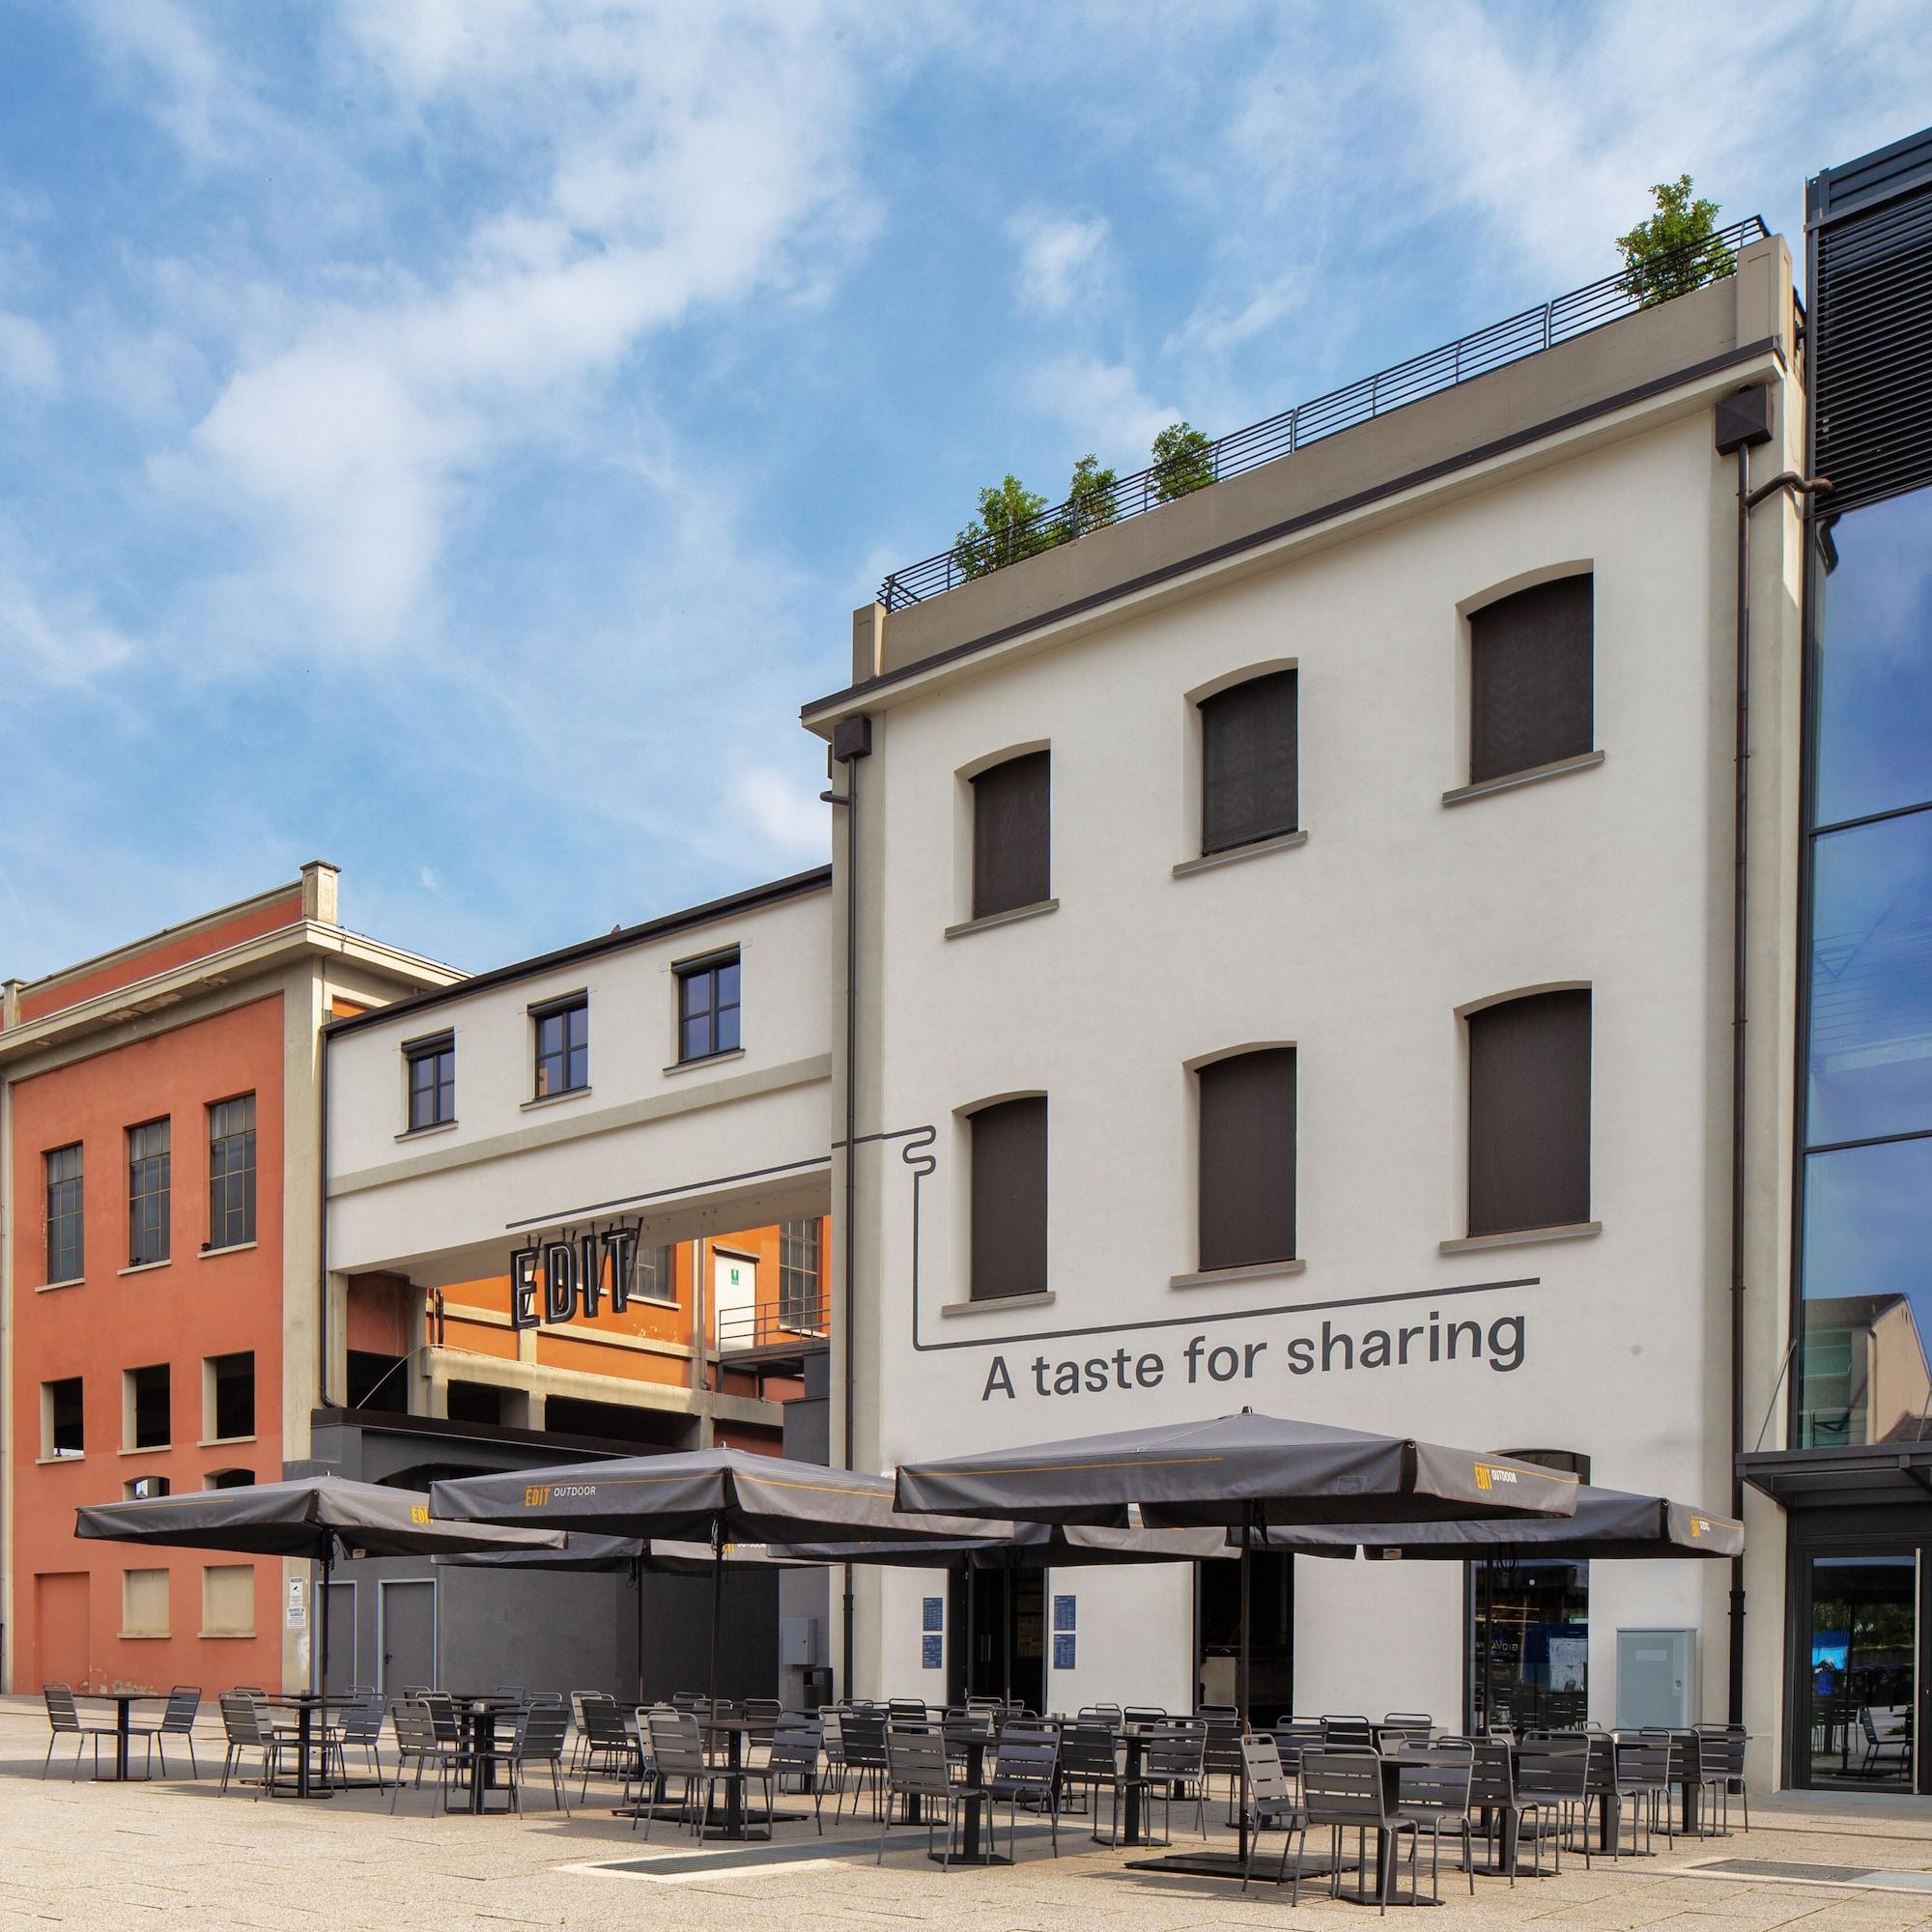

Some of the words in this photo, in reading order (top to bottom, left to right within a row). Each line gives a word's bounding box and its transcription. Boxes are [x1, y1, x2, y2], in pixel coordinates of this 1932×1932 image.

[510, 1227, 638, 1330] EDIT
[982, 1356, 1016, 1402] A
[1031, 1349, 1164, 1397] taste
[1182, 1336, 1267, 1384] for
[1287, 1310, 1525, 1373] sharing
[525, 1485, 551, 1507] EDIT
[554, 1486, 596, 1497] OUTDOOR
[1474, 1463, 1492, 1490] EDIT
[1491, 1468, 1518, 1484] OUTDOOR
